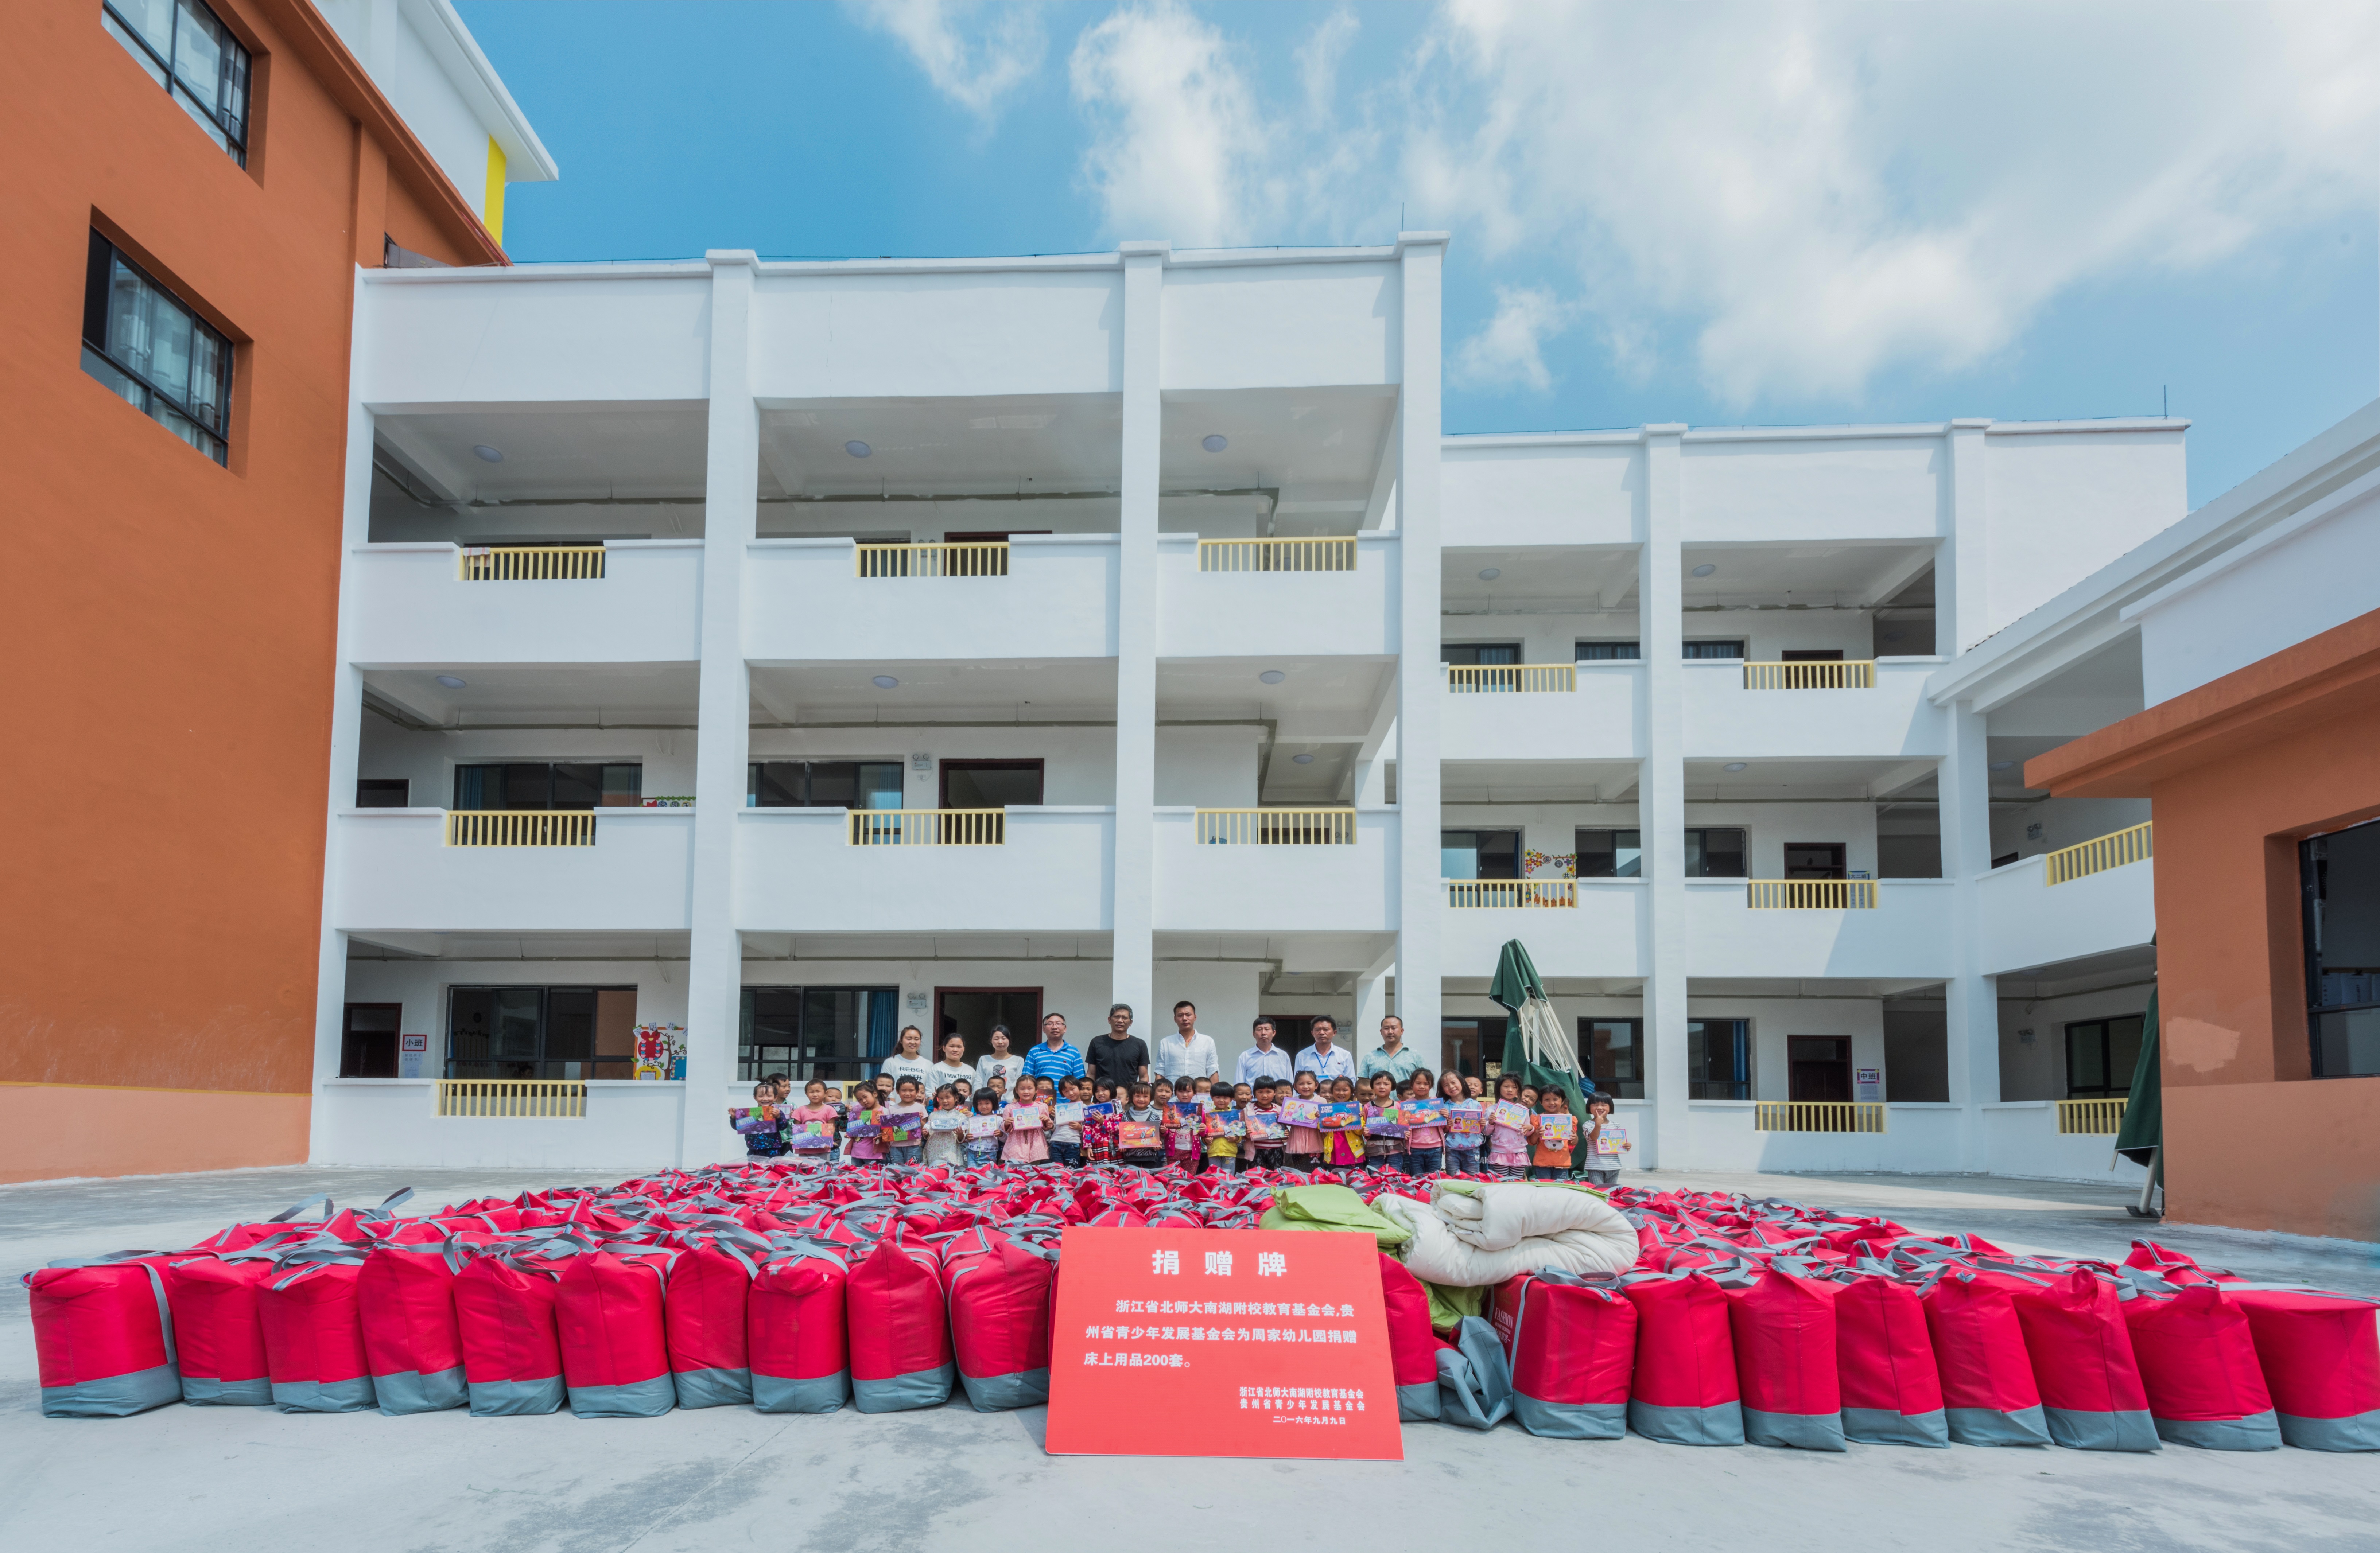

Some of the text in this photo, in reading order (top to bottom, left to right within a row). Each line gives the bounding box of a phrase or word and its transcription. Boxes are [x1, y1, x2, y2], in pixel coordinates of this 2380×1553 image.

[1152, 1249, 1287, 1277] 捐赠牌
[1115, 1300, 1354, 1317] 浙江省北师大南湖附校教育基金会,贵
[1494, 1307, 1514, 1329] FASHION
[1085, 1326, 1357, 1343] 州省青少年发展基金会为周家幼儿园捐赠
[1084, 1352, 1190, 1367] 床上用品200套。
[1239, 1386, 1364, 1399] 浙江省北师大南湖附校教育基金会
[1240, 1398, 1365, 1411] 贵州省青少年发展基金会
